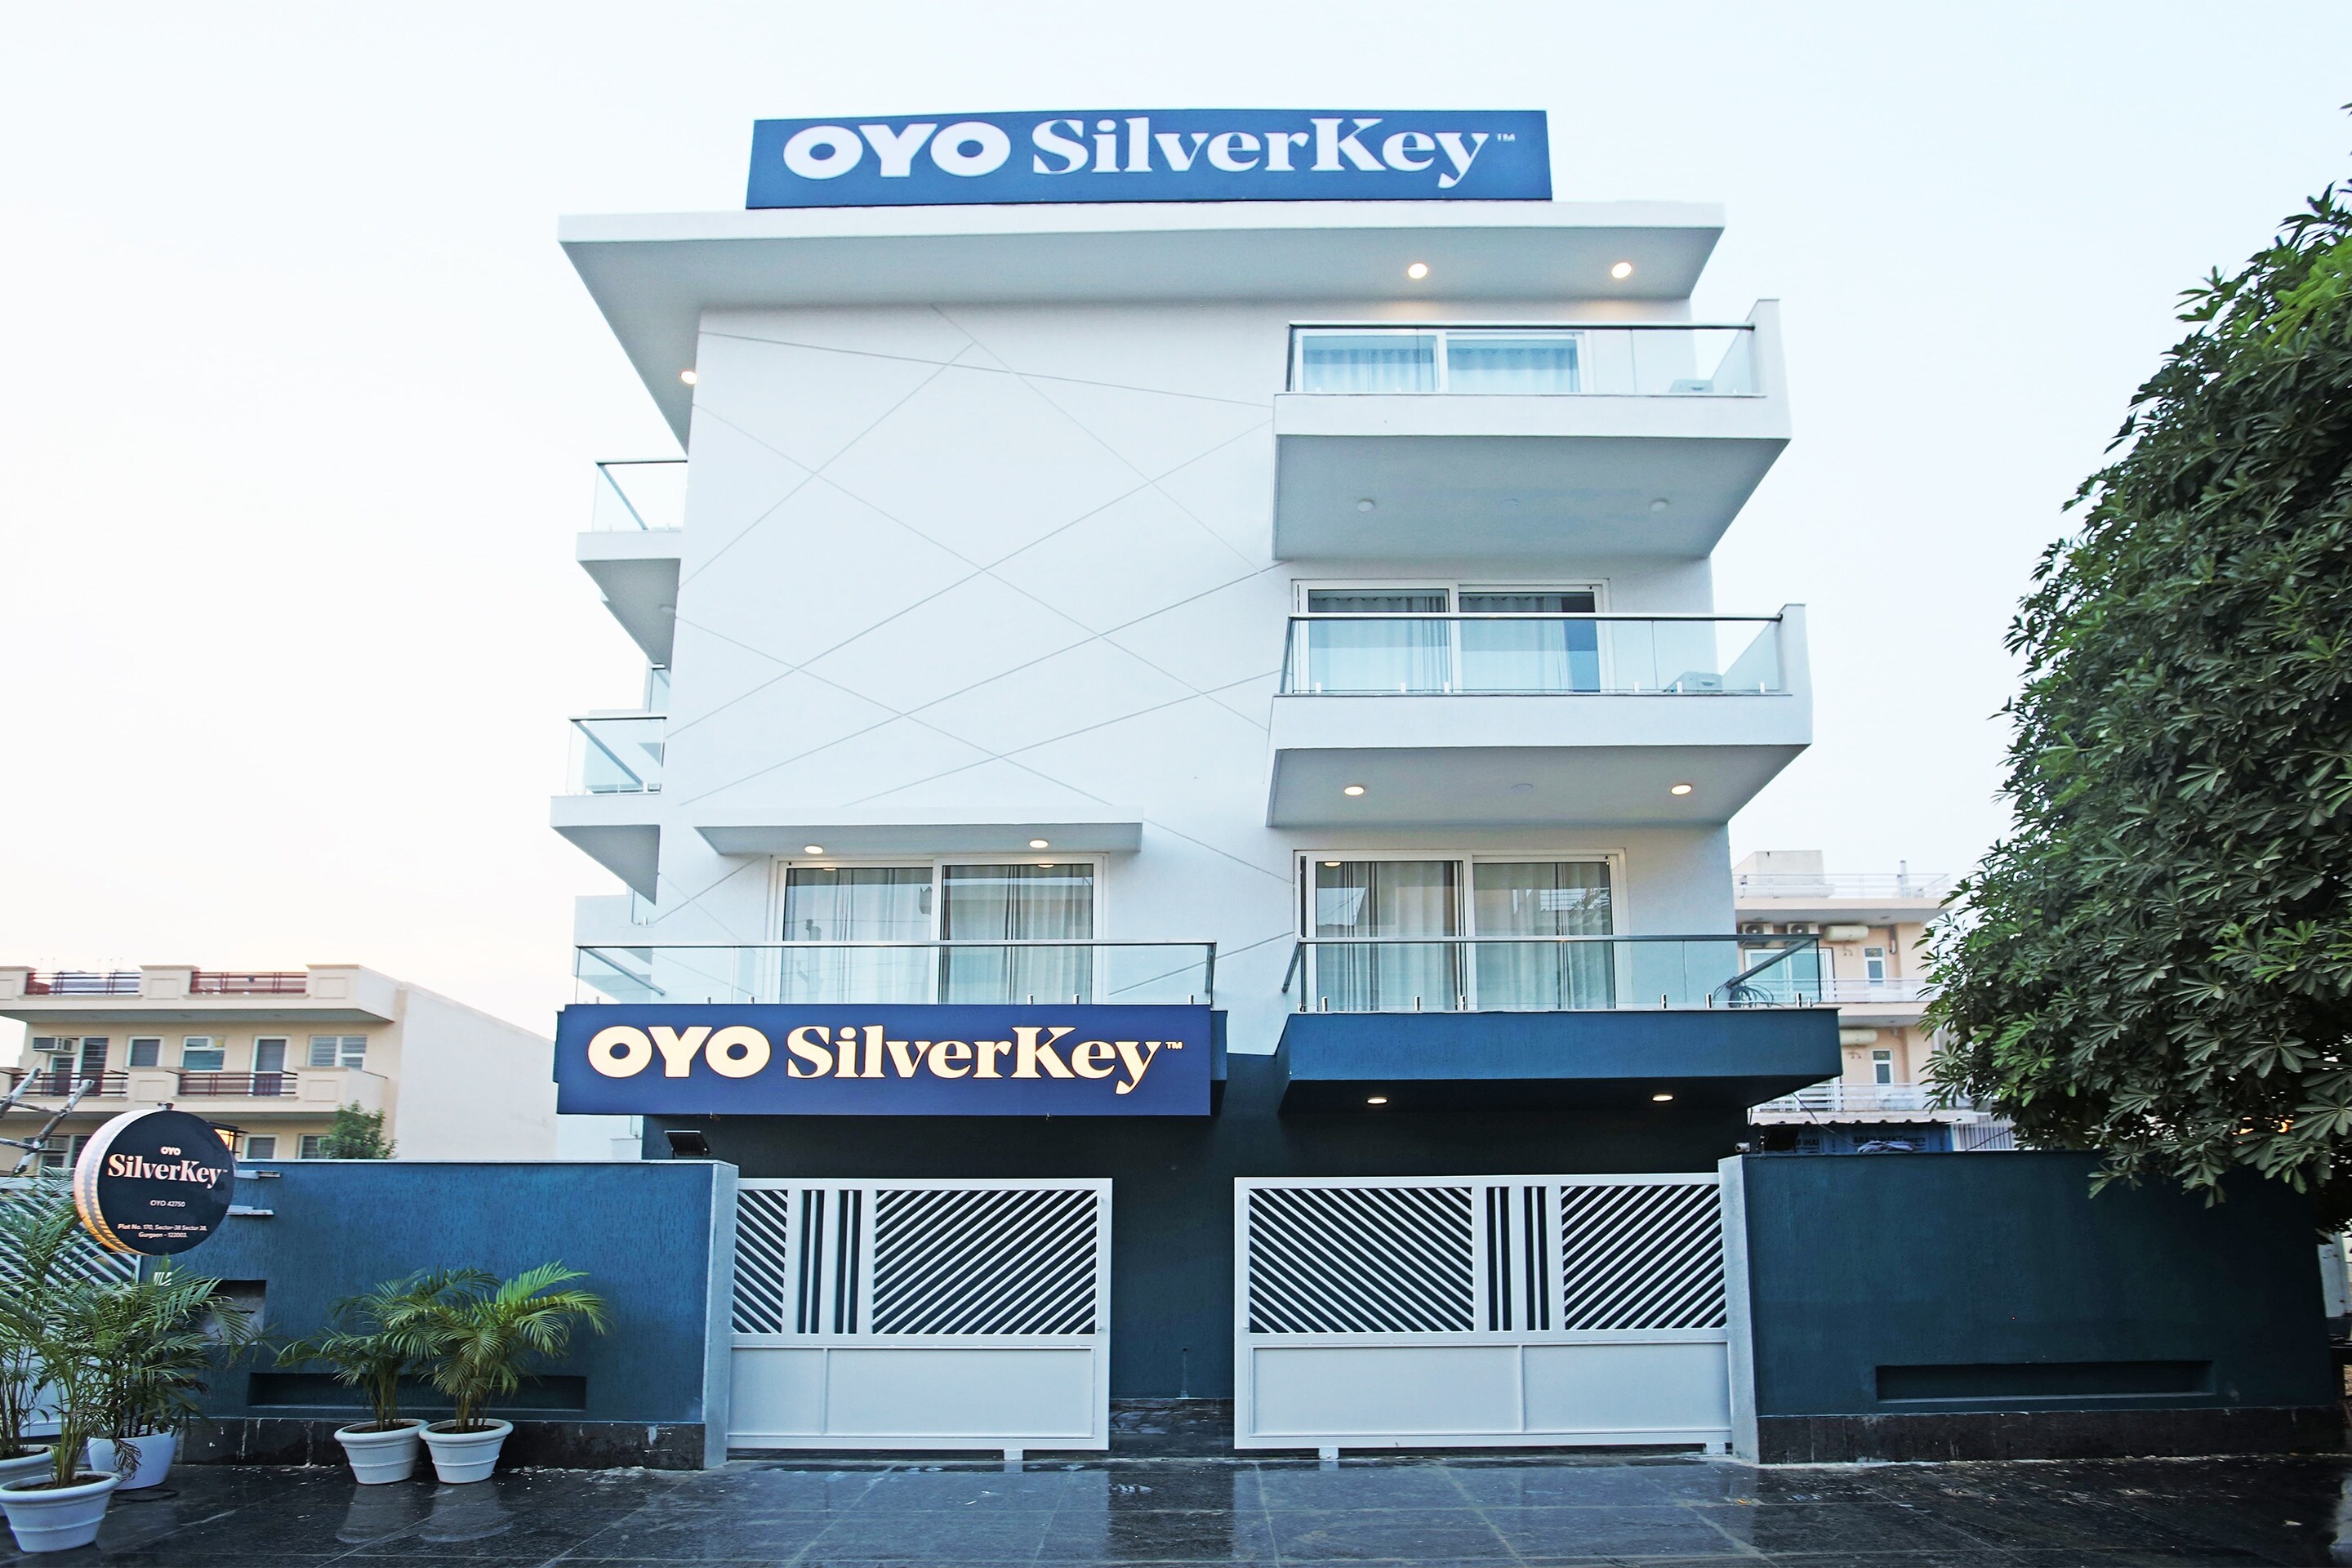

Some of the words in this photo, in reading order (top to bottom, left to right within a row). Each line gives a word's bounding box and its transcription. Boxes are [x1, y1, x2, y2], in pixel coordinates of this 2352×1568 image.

[782, 121, 1011, 179] OYO
[1031, 116, 1490, 189] SilverKey
[587, 1025, 772, 1079] OYO
[786, 1024, 1162, 1096] SilverKey
[108, 1153, 222, 1189] SilverKey
[160, 1146, 181, 1156] OYO
